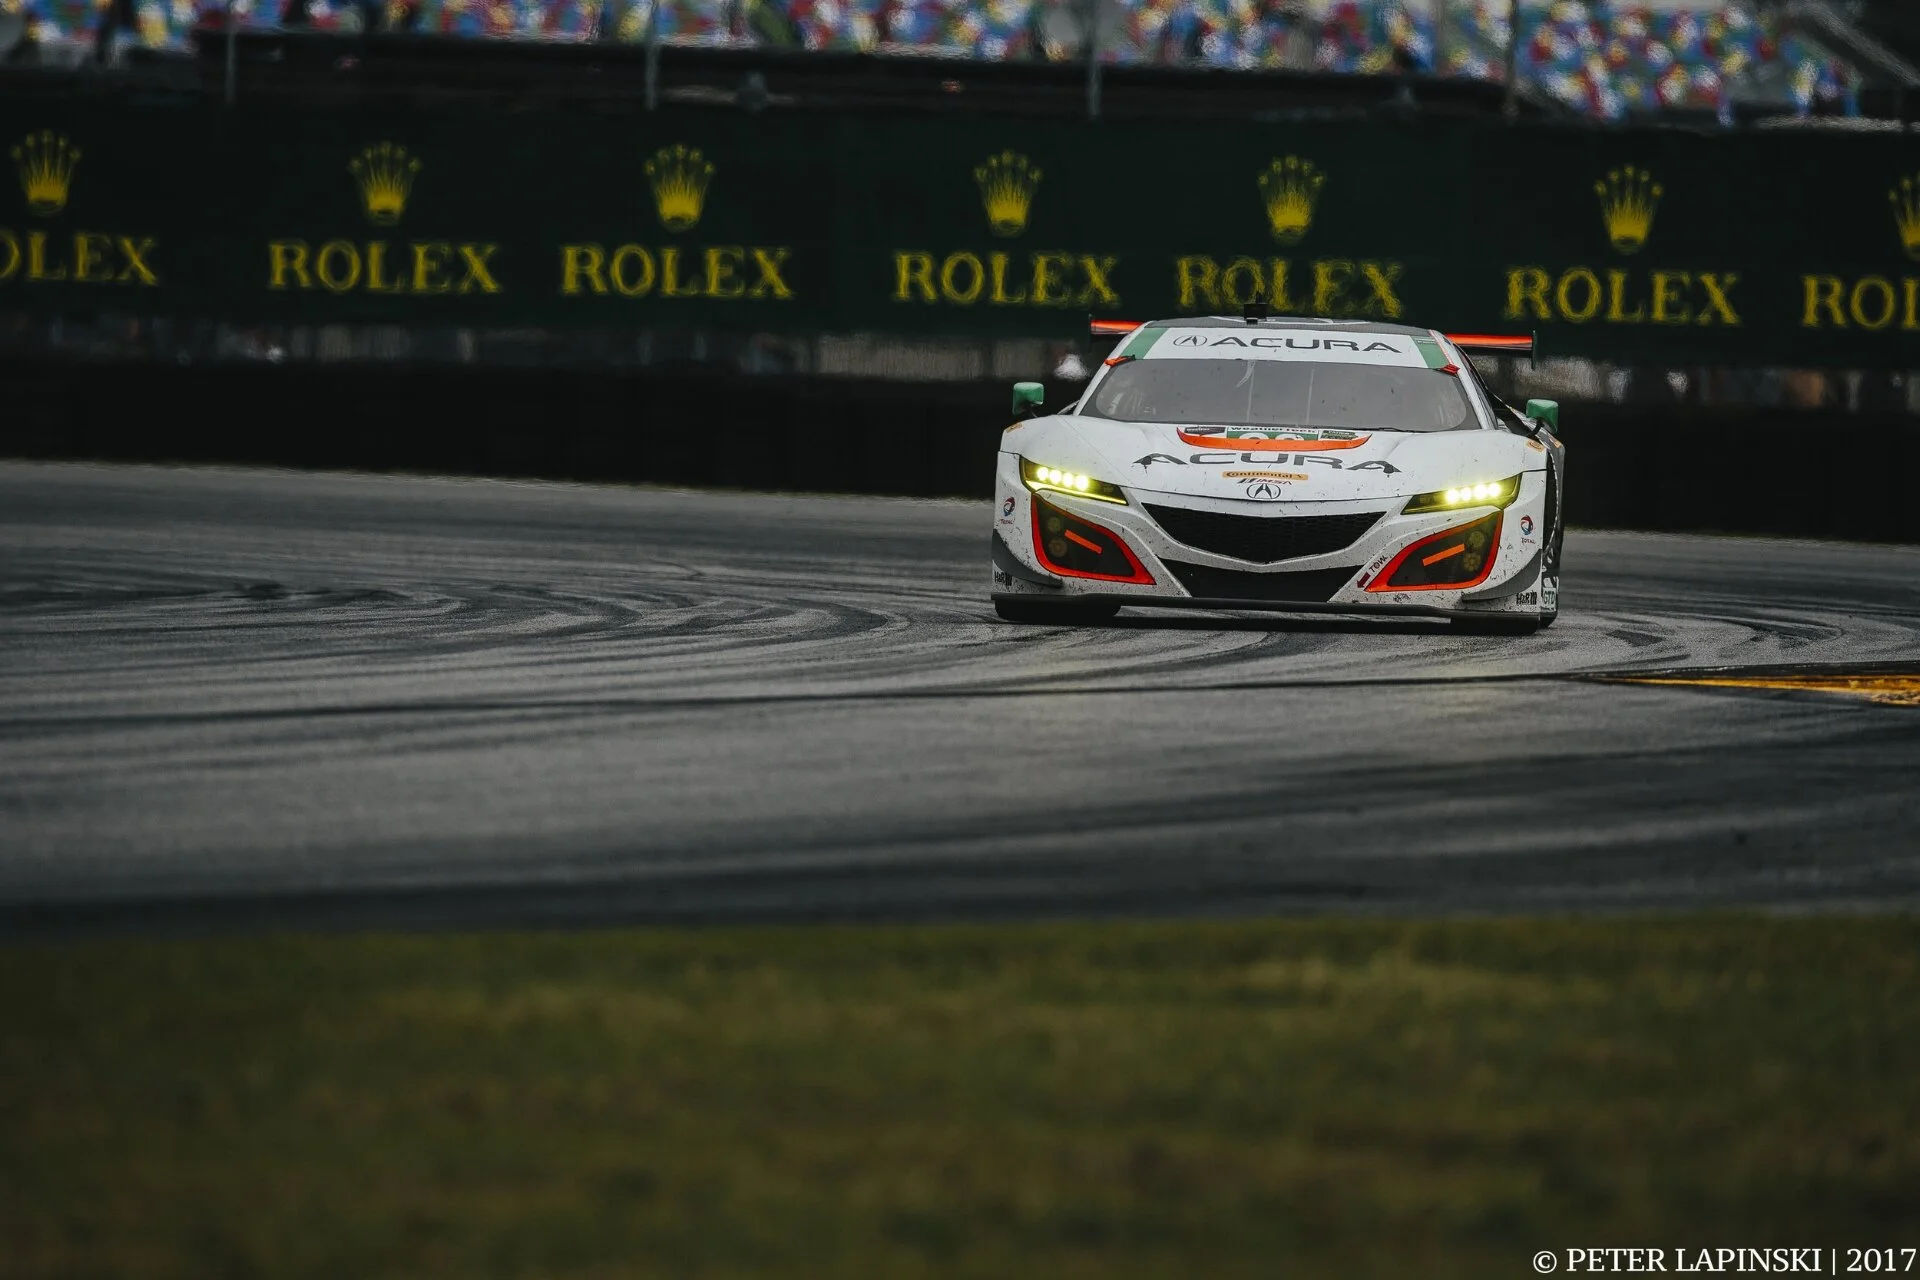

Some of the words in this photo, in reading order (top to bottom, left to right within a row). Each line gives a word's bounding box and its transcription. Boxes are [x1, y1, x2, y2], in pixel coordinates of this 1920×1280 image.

[268, 240, 501, 294] ROLEX
[560, 243, 794, 300] ROLEX
[892, 250, 1120, 308] ROLEX
[1176, 256, 1402, 318] ROLEX
[1504, 266, 1740, 326] ROLEX
[1210, 336, 1402, 353] ACURA
[1133, 453, 1401, 473] ACURA
[1226, 471, 1293, 479] Continental
